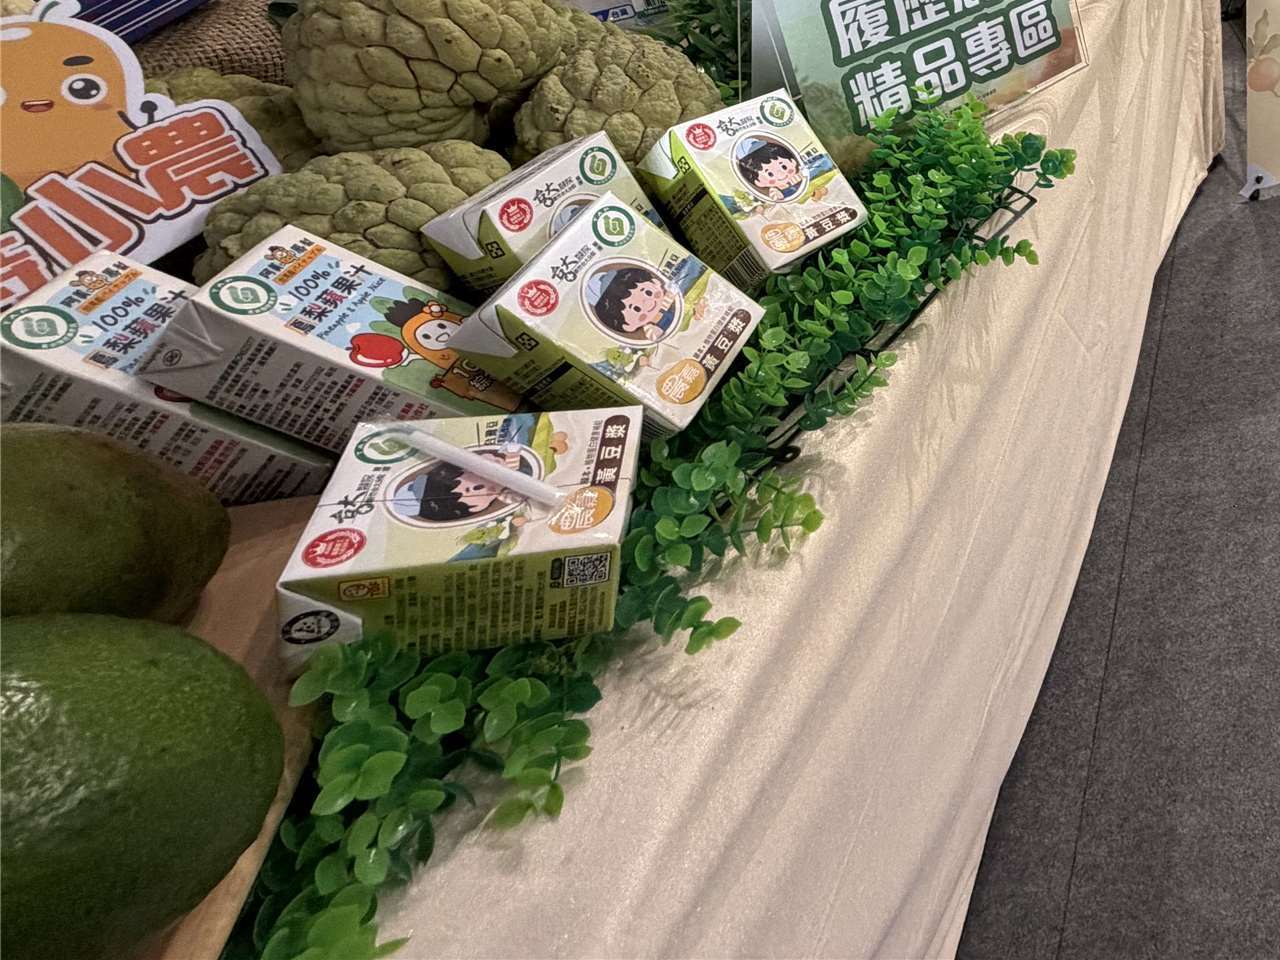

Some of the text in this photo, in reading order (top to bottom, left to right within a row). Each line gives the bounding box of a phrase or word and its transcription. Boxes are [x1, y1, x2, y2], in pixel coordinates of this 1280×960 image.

[288, 270, 332, 302] 100%
[92, 296, 146, 332] 100%
[702, 317, 746, 372] 黃豆漿
[595, 422, 627, 485] 黃豆漿
